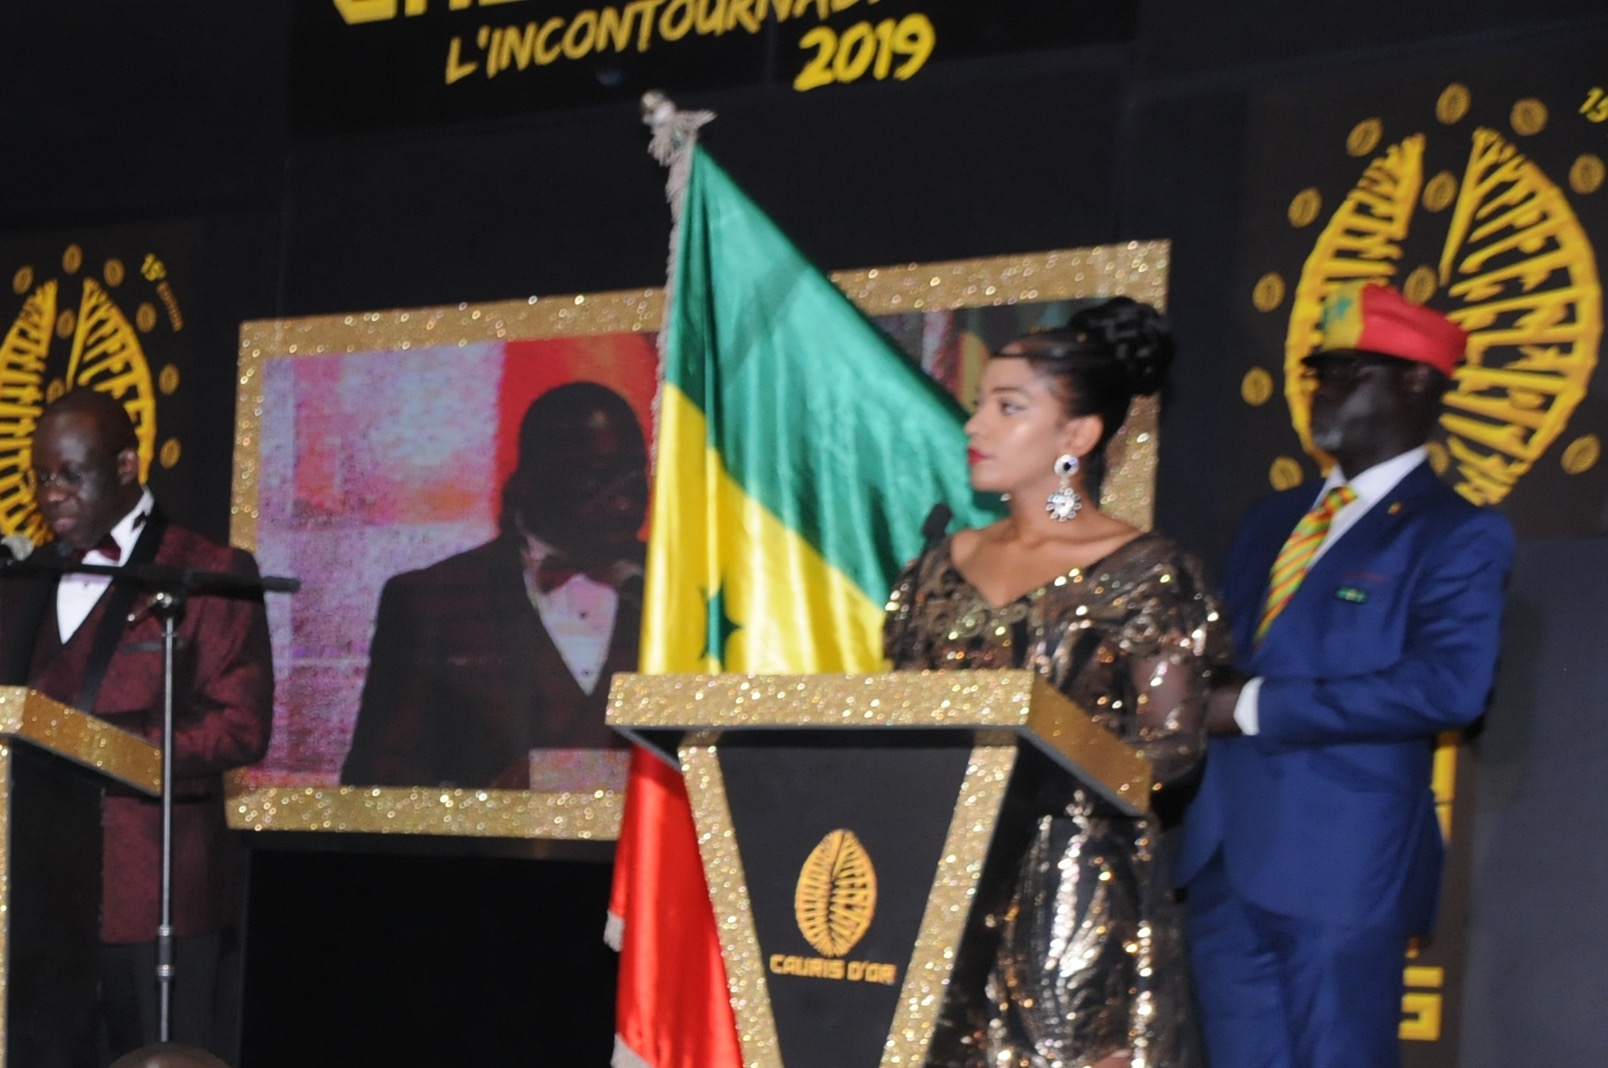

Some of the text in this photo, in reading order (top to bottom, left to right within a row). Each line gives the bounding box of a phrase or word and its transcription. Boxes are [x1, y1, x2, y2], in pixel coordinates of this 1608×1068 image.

[794, 13, 935, 92] 2019
[770, 954, 897, 986] CAURIS D'OR
